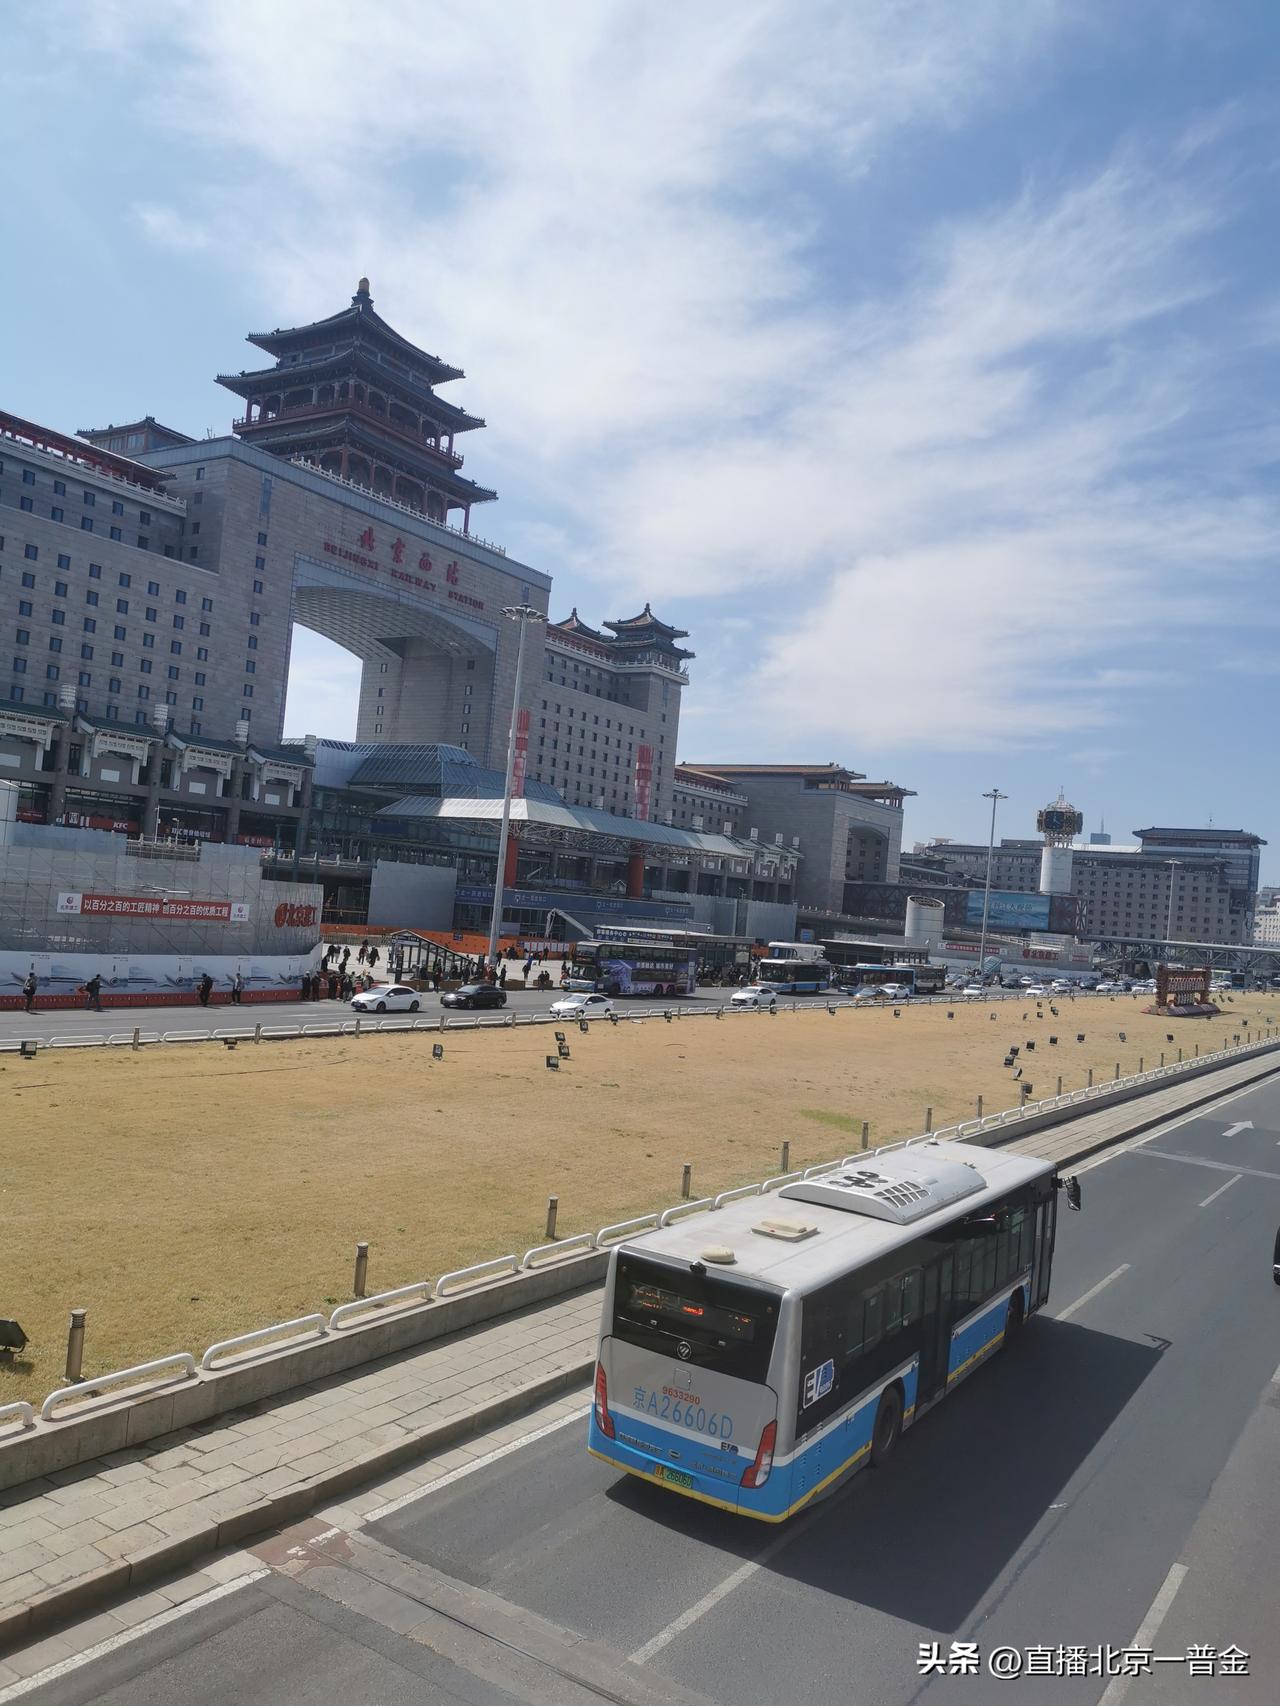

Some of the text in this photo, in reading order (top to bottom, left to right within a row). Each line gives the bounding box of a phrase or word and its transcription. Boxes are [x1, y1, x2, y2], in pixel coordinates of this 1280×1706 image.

[390, 568, 437, 592] RAILWAY
[448, 590, 485, 611] STATION
[113, 822, 129, 830] KFC
[83, 899, 160, 914] 以百分之百的工匠精神
[662, 1386, 701, 1405] 9633290
[633, 1385, 734, 1440] 京A26606D
